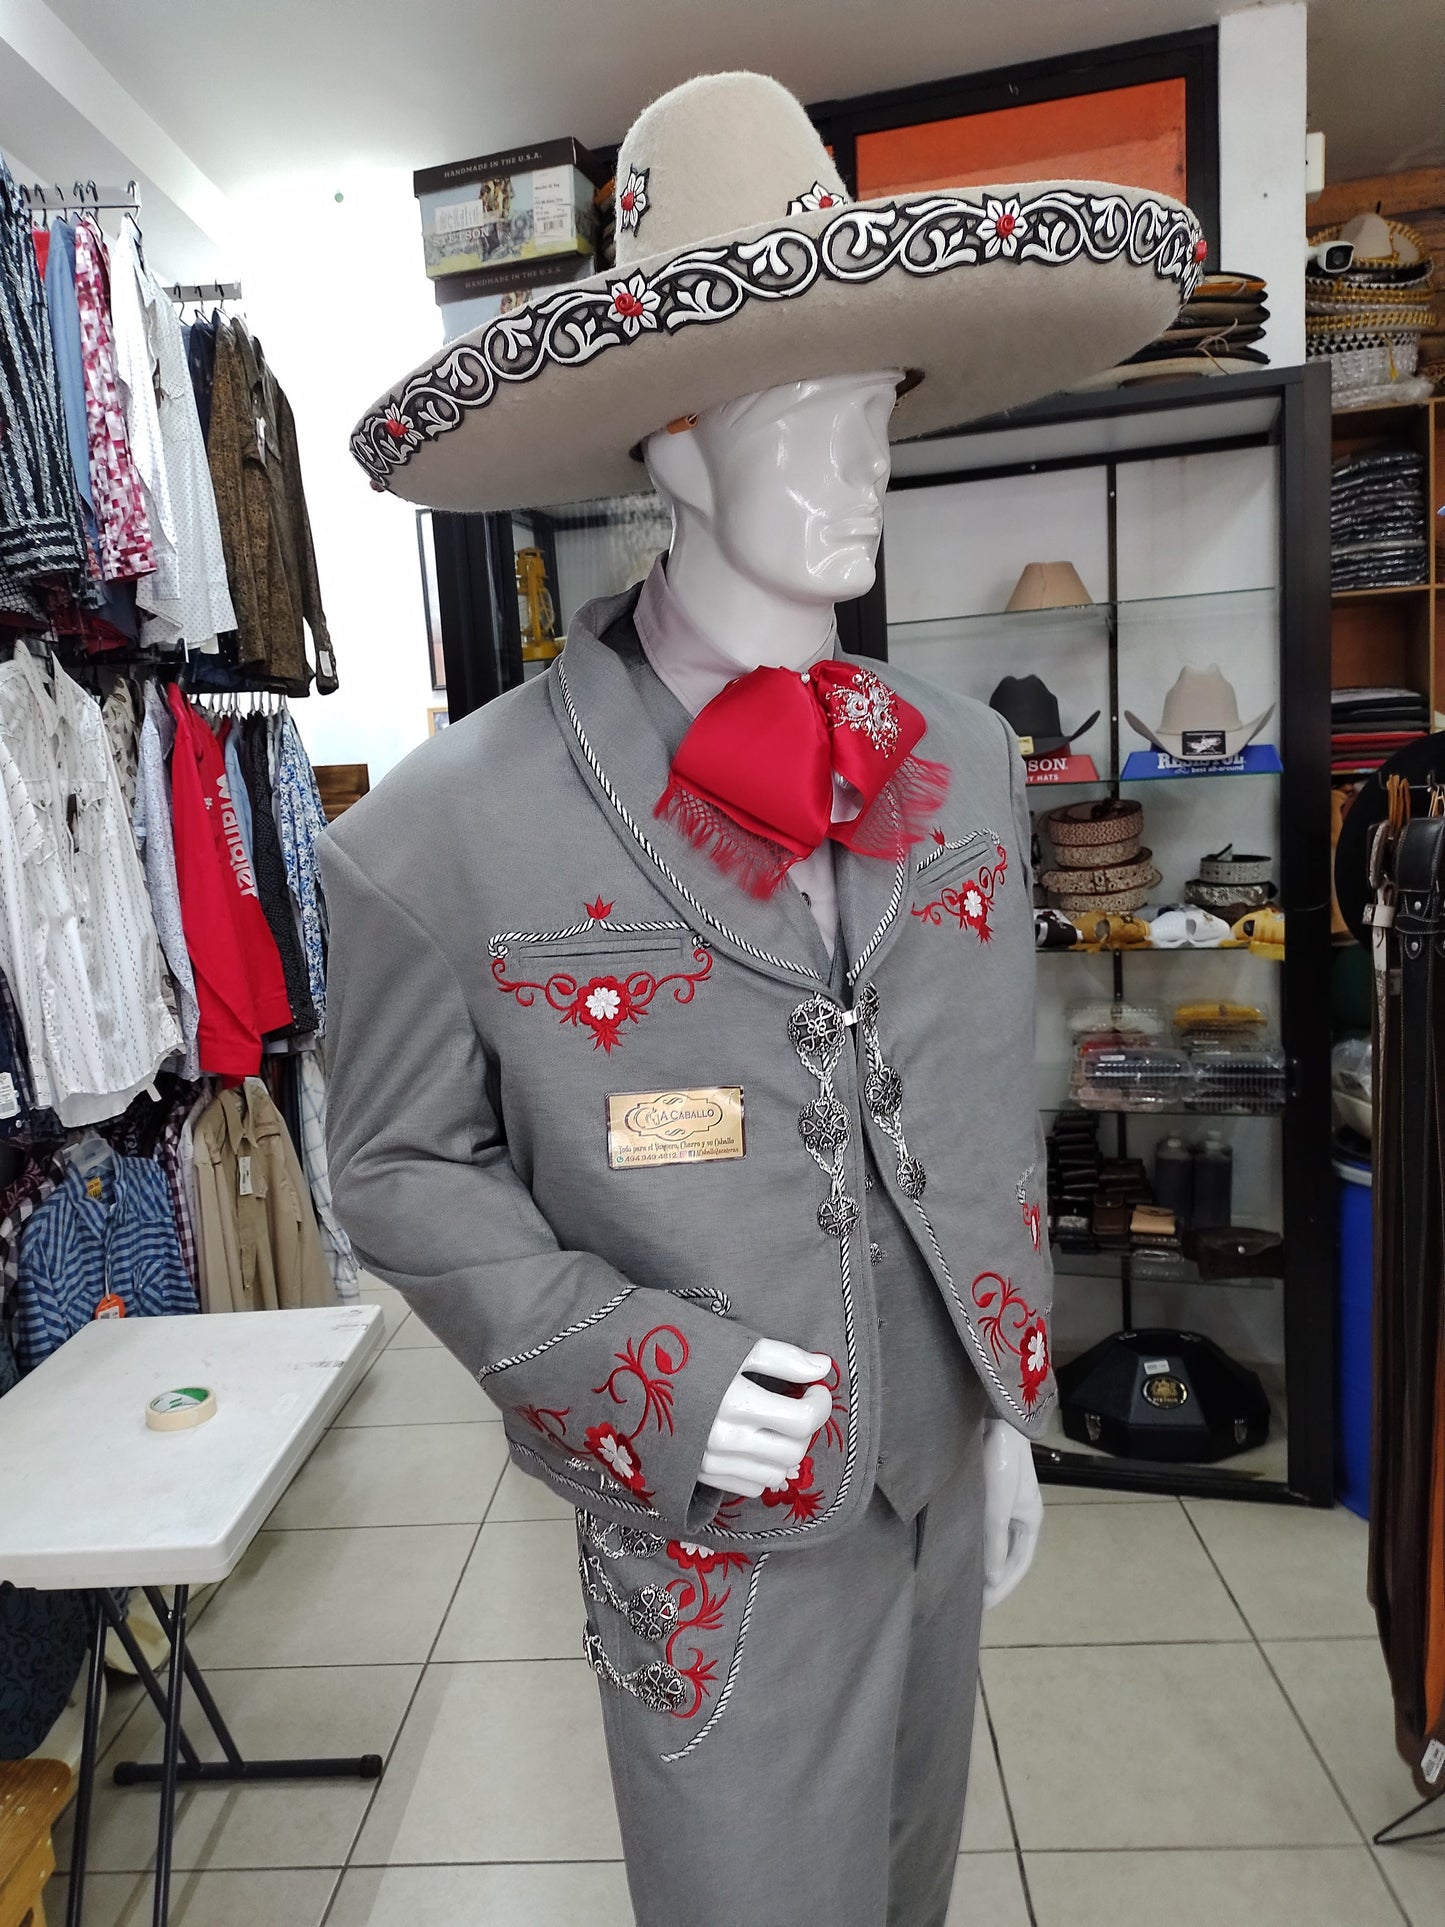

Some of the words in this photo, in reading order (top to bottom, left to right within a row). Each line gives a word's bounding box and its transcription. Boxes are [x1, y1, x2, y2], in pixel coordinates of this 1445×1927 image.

[444, 162, 488, 178] HANDMADE
[490, 160, 499, 168] IN
[501, 157, 516, 166] THE
[518, 152, 542, 163] U.S.A.
[432, 226, 489, 247] STETSON
[465, 275, 509, 289] HANDMADE
[522, 270, 537, 279] THE
[661, 1110, 668, 1121] A
